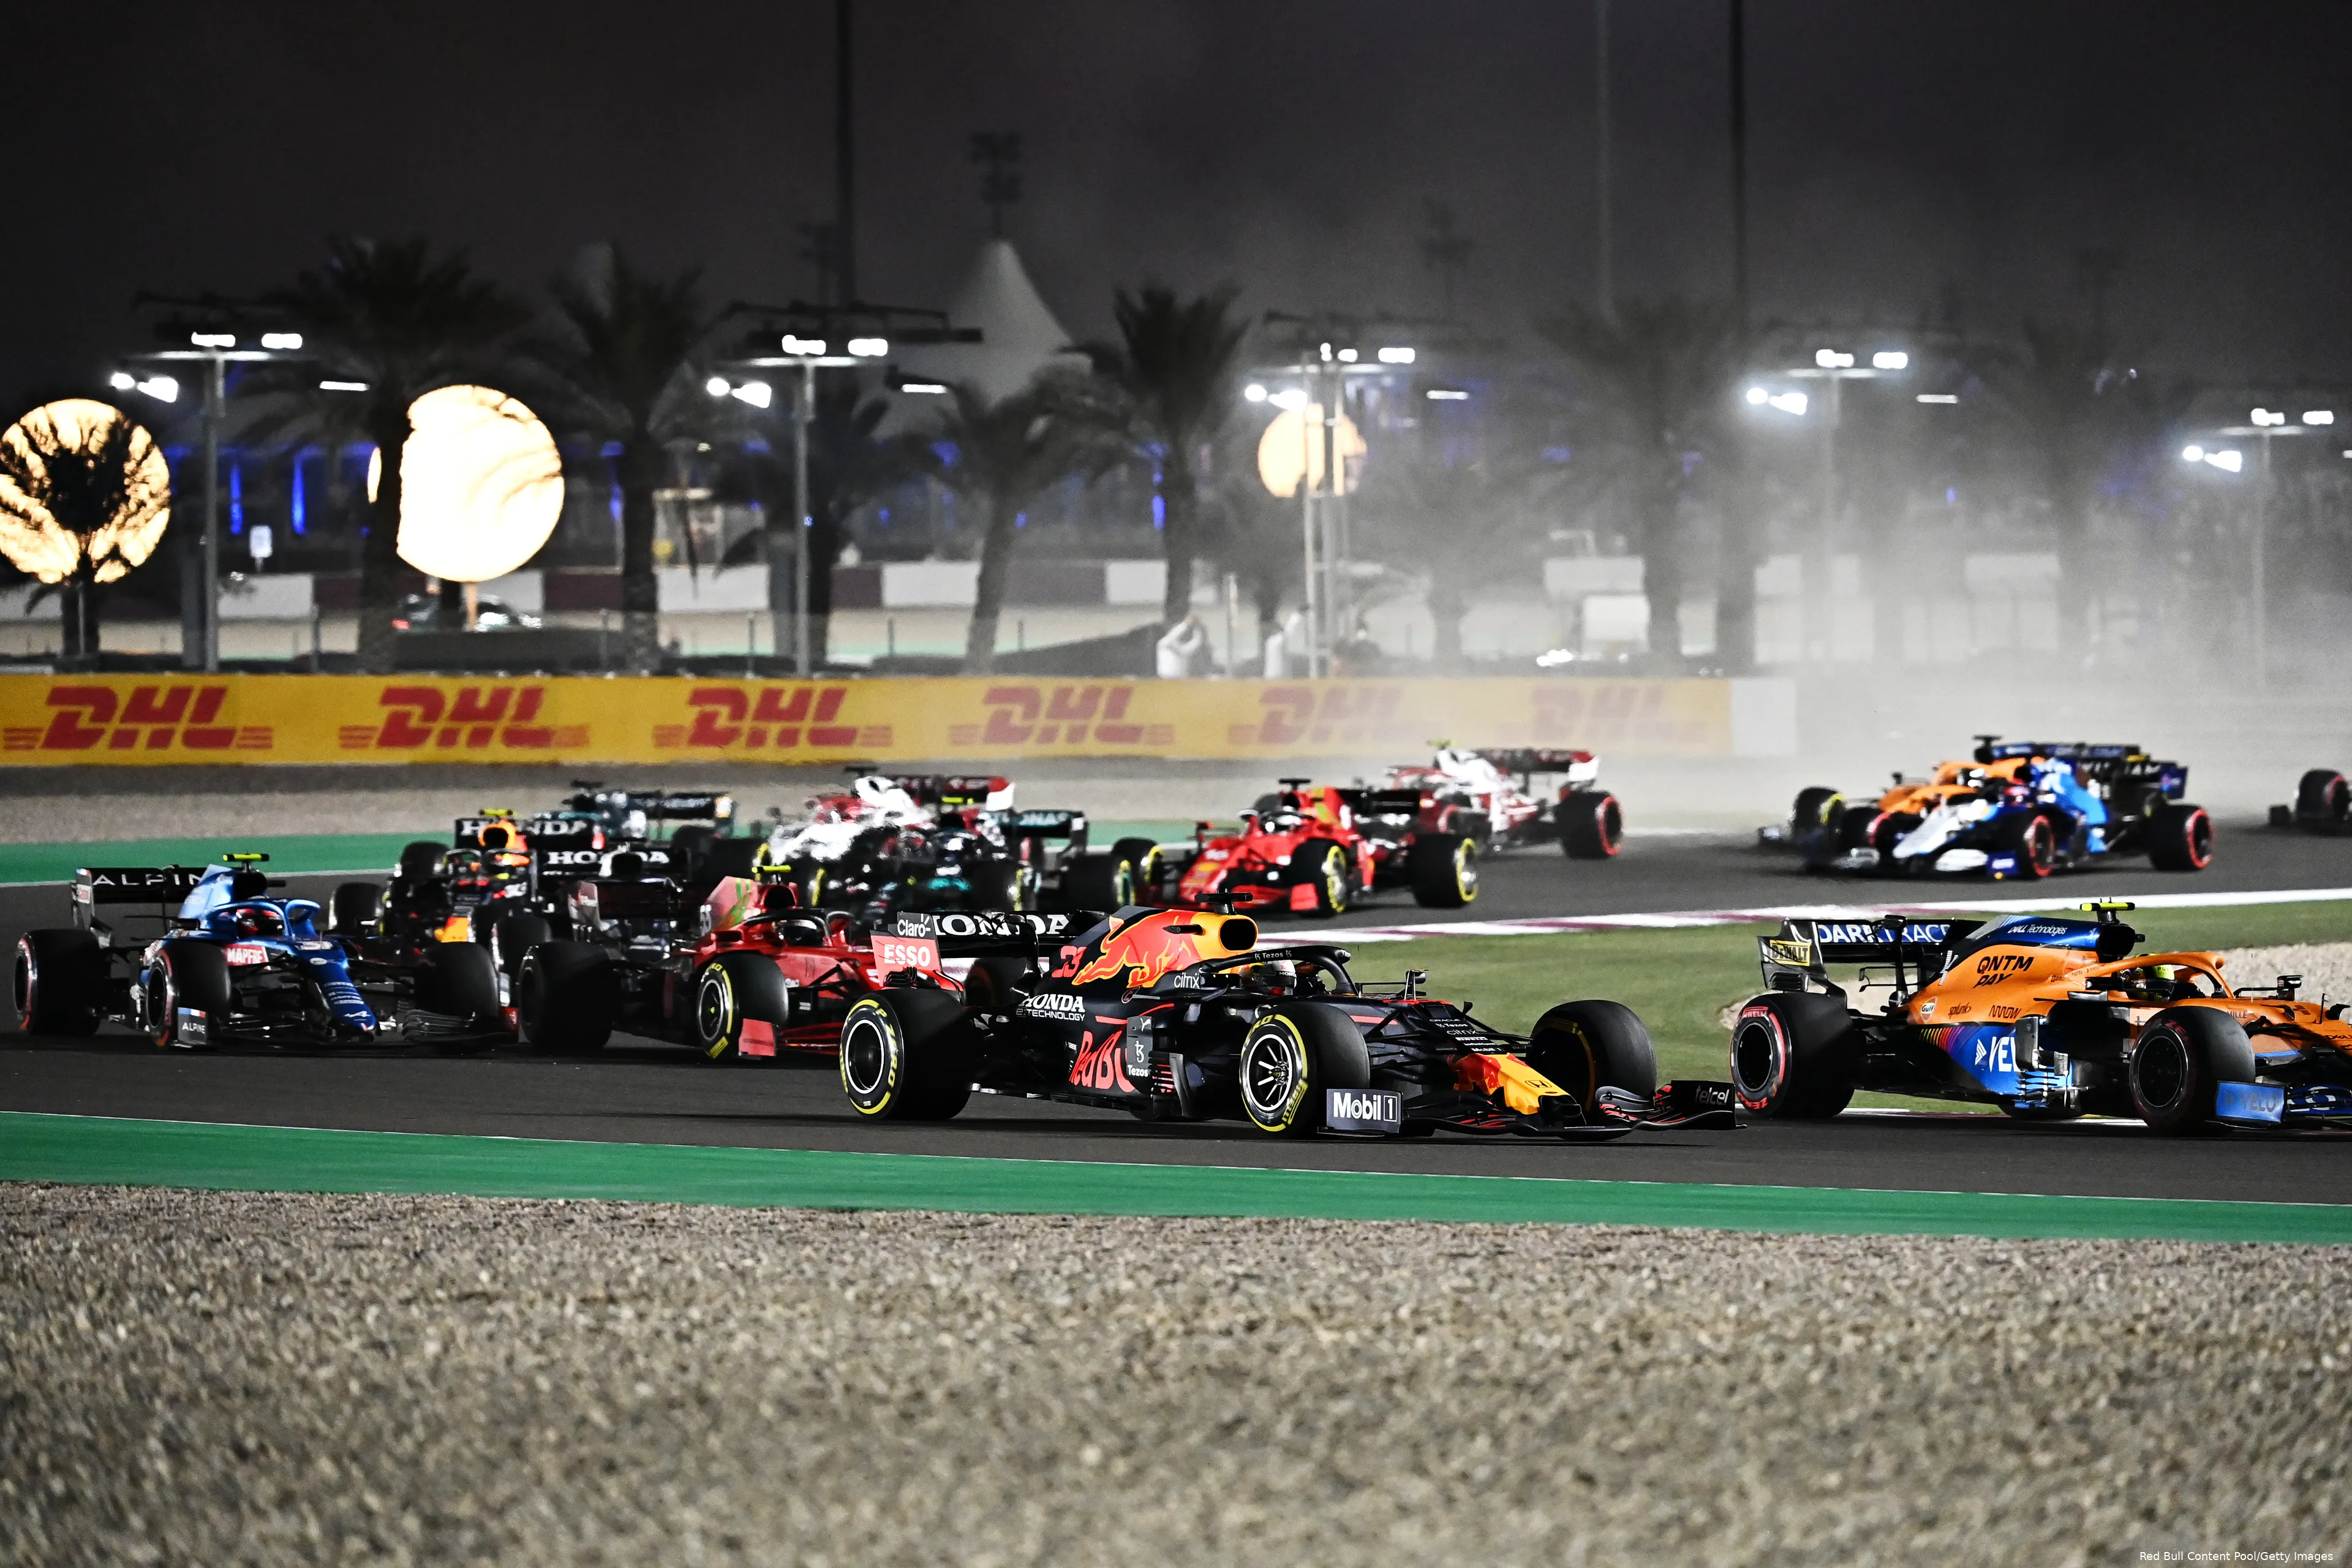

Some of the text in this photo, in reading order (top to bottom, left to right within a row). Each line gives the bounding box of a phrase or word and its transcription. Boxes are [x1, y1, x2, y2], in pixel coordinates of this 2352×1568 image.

[40, 685, 237, 750] DHL
[377, 685, 553, 749] DHL
[688, 687, 858, 747] DHL
[982, 687, 1144, 744] DHL
[1257, 686, 1412, 744] DHL
[1530, 685, 1674, 742] DHL
[92, 873, 203, 886] ALPIN
[897, 918, 927, 938] Claro
[2027, 924, 2068, 936] Technologies
[227, 948, 264, 965] MAPFRE
[884, 944, 931, 967] ESSO
[1173, 973, 1200, 989] citrix
[1972, 973, 2014, 989] PAY
[1018, 993, 1086, 1013] HONDA
[182, 1022, 206, 1034] ALPINE
[1989, 1036, 2022, 1072] VEL
[1127, 1065, 1149, 1077] Tezos
[1333, 1091, 1382, 1121] Mobil
[1694, 1085, 1730, 1106] telcel
[2239, 1091, 2279, 1113] VELO
